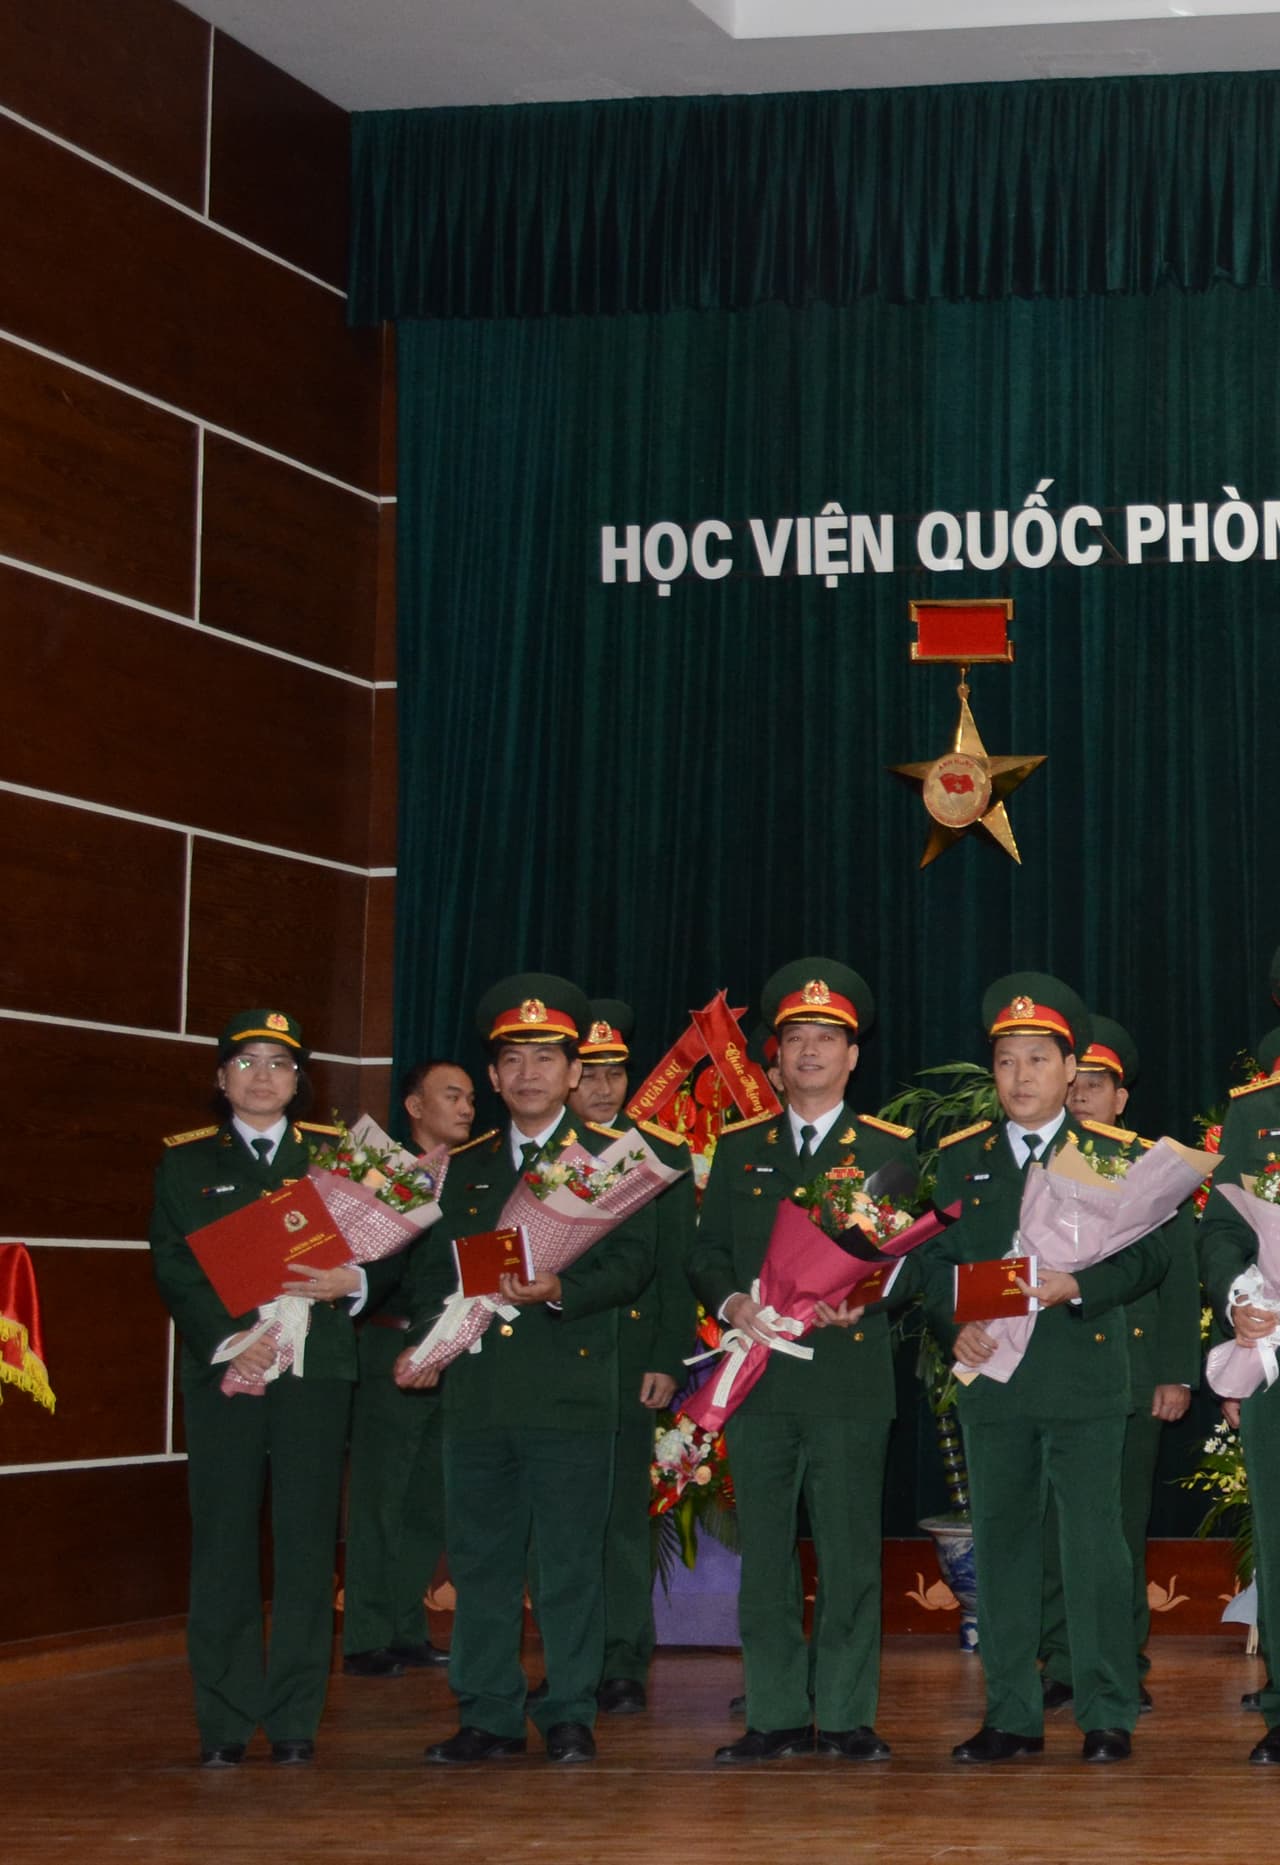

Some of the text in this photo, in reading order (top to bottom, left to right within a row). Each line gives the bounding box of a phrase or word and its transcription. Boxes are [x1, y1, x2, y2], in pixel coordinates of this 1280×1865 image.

[601, 519, 733, 597] HỌC
[749, 501, 894, 589] VIỆN
[916, 478, 1103, 572] QUỐC
